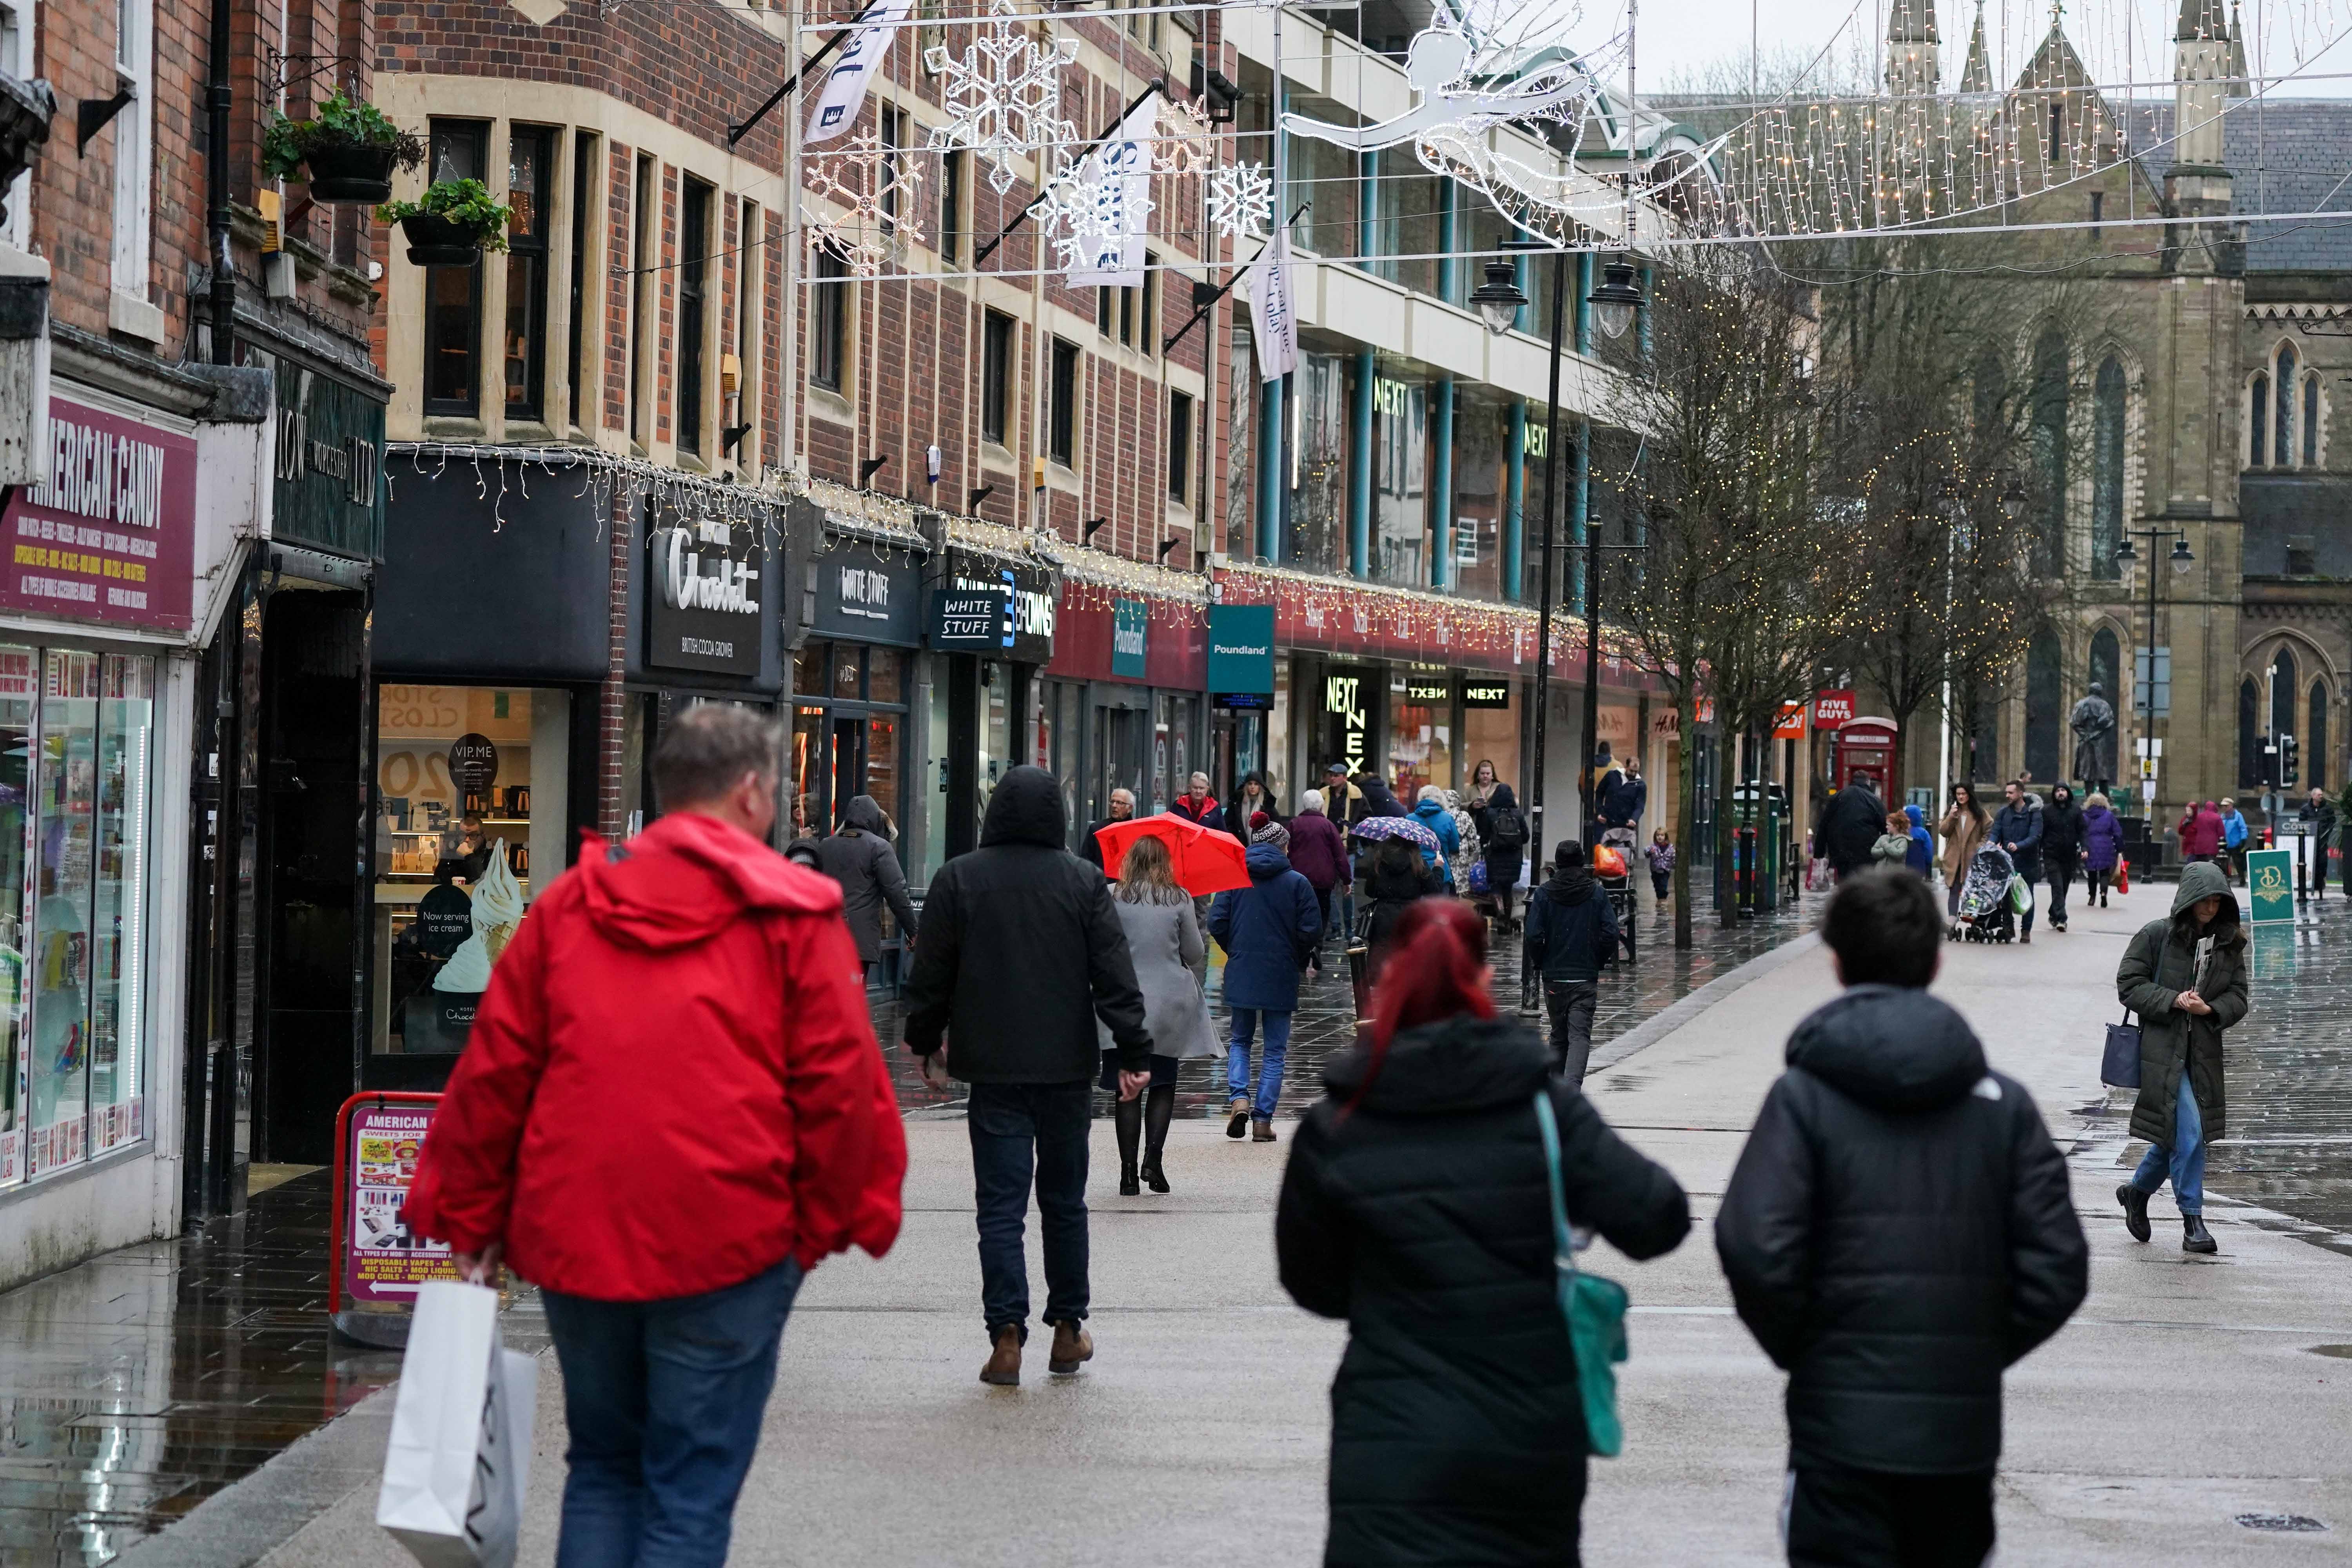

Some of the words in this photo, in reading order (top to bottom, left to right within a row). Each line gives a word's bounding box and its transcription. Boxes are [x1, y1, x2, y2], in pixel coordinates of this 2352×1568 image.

[1374, 375, 1406, 417] NEXT
[27, 417, 113, 519] MERICAN
[116, 435, 164, 529] CANDY
[354, 436, 376, 507] LTD
[842, 566, 866, 603] WHITE
[867, 570, 889, 606] STUFF
[945, 600, 992, 613] WHITE
[1016, 590, 1053, 637] BROWNS
[942, 621, 990, 634] STUFF
[1114, 621, 1145, 656] Poundland
[682, 637, 698, 653] BRITISH
[699, 639, 715, 655] COCOA
[715, 641, 733, 658] GROWER
[1214, 644, 1265, 655] Poundland
[1327, 676, 1359, 713] NEXT
[1467, 688, 1506, 700] NEXT
[1821, 700, 1848, 710] FIVE
[1817, 710, 1851, 719] GUYS
[455, 746, 492, 757] VIP.ME
[1345, 709, 1365, 779] NEX
[423, 911, 442, 920] Now
[444, 913, 469, 923] serving
[365, 1115, 427, 1129] AMERICAN
